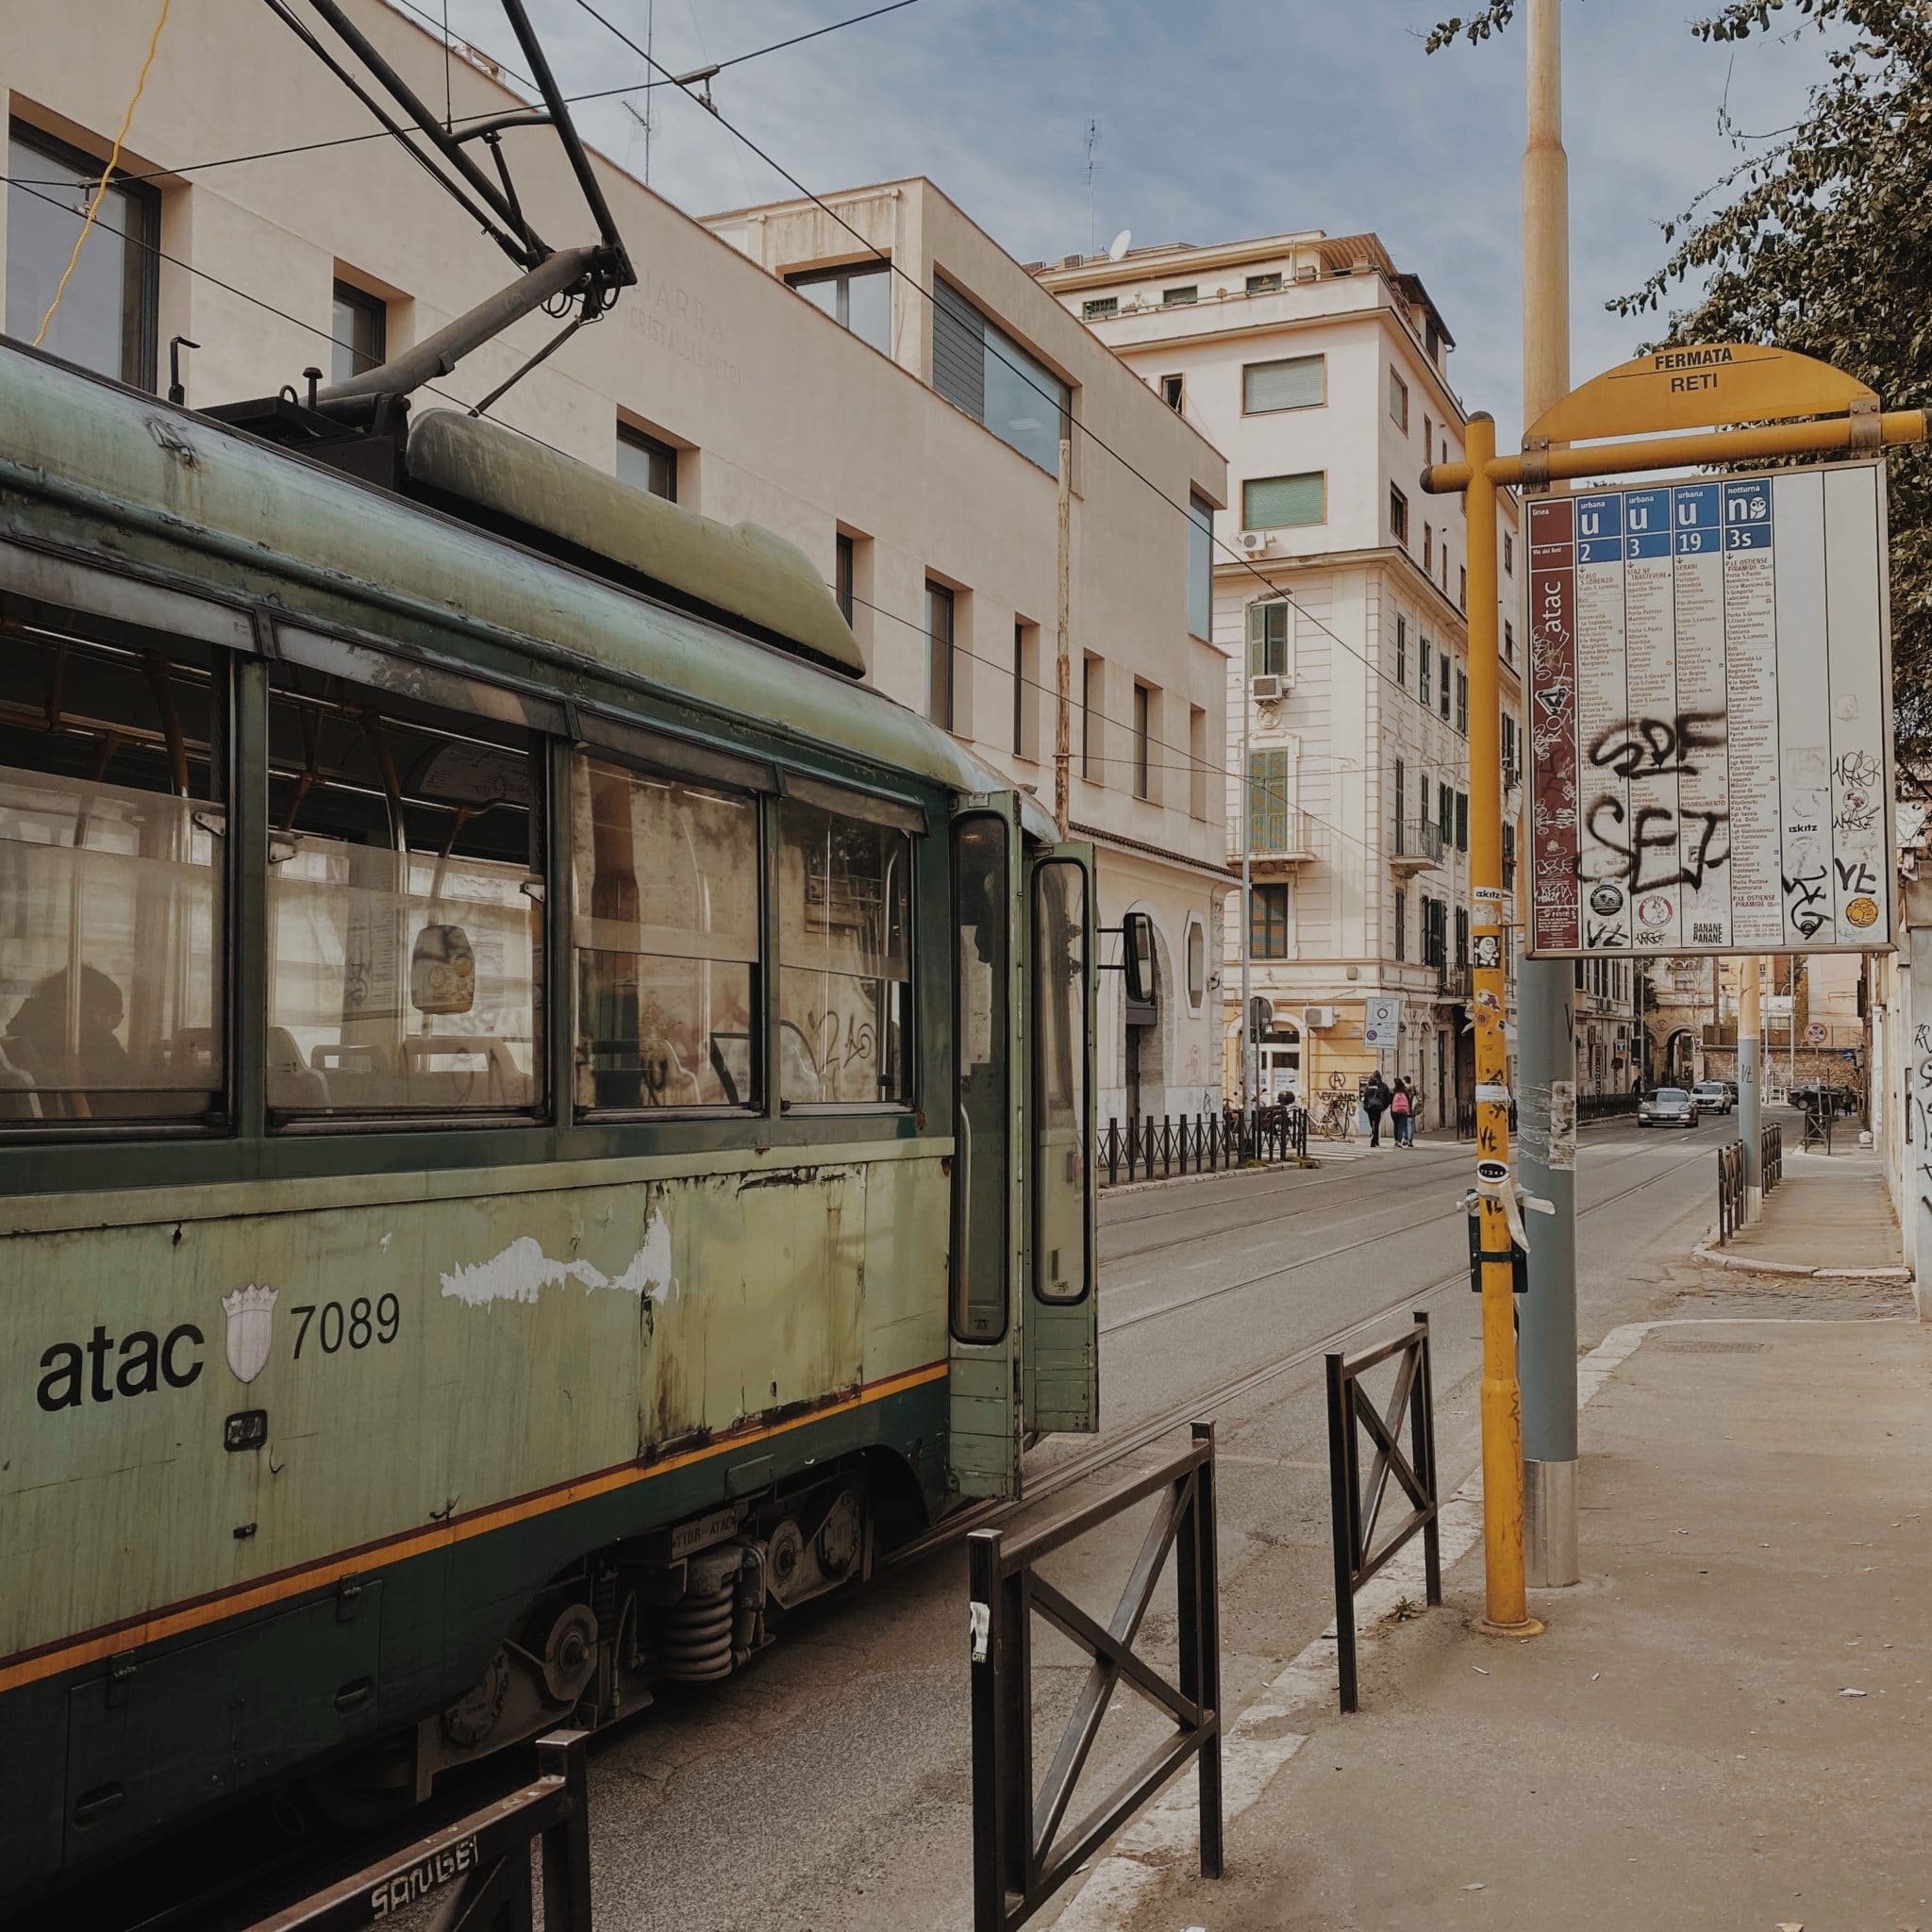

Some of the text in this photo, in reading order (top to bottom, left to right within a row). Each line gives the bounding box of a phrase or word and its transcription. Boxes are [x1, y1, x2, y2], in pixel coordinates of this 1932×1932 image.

[1655, 347, 1732, 371] FERMATA
[1671, 373, 1718, 393] RETI
[1629, 495, 1655, 505] urbana
[1678, 490, 1704, 500] urbana
[1728, 485, 1761, 495] notturna
[1532, 507, 1550, 516] linea
[1580, 500, 1606, 510] urbana
[1678, 501, 1697, 525] u
[1581, 512, 1599, 535] u
[1629, 507, 1648, 531] u
[1630, 538, 1641, 557] 3
[1679, 532, 1702, 552] 19
[1730, 529, 1752, 549] 3s
[1580, 543, 1591, 562] 2
[1631, 572, 1667, 581] TRASTEVERE
[1542, 581, 1562, 633] atac
[1681, 800, 1726, 809] RISORGIMENTO
[290, 1292, 401, 1360] 7089
[36, 1324, 205, 1413] atac
